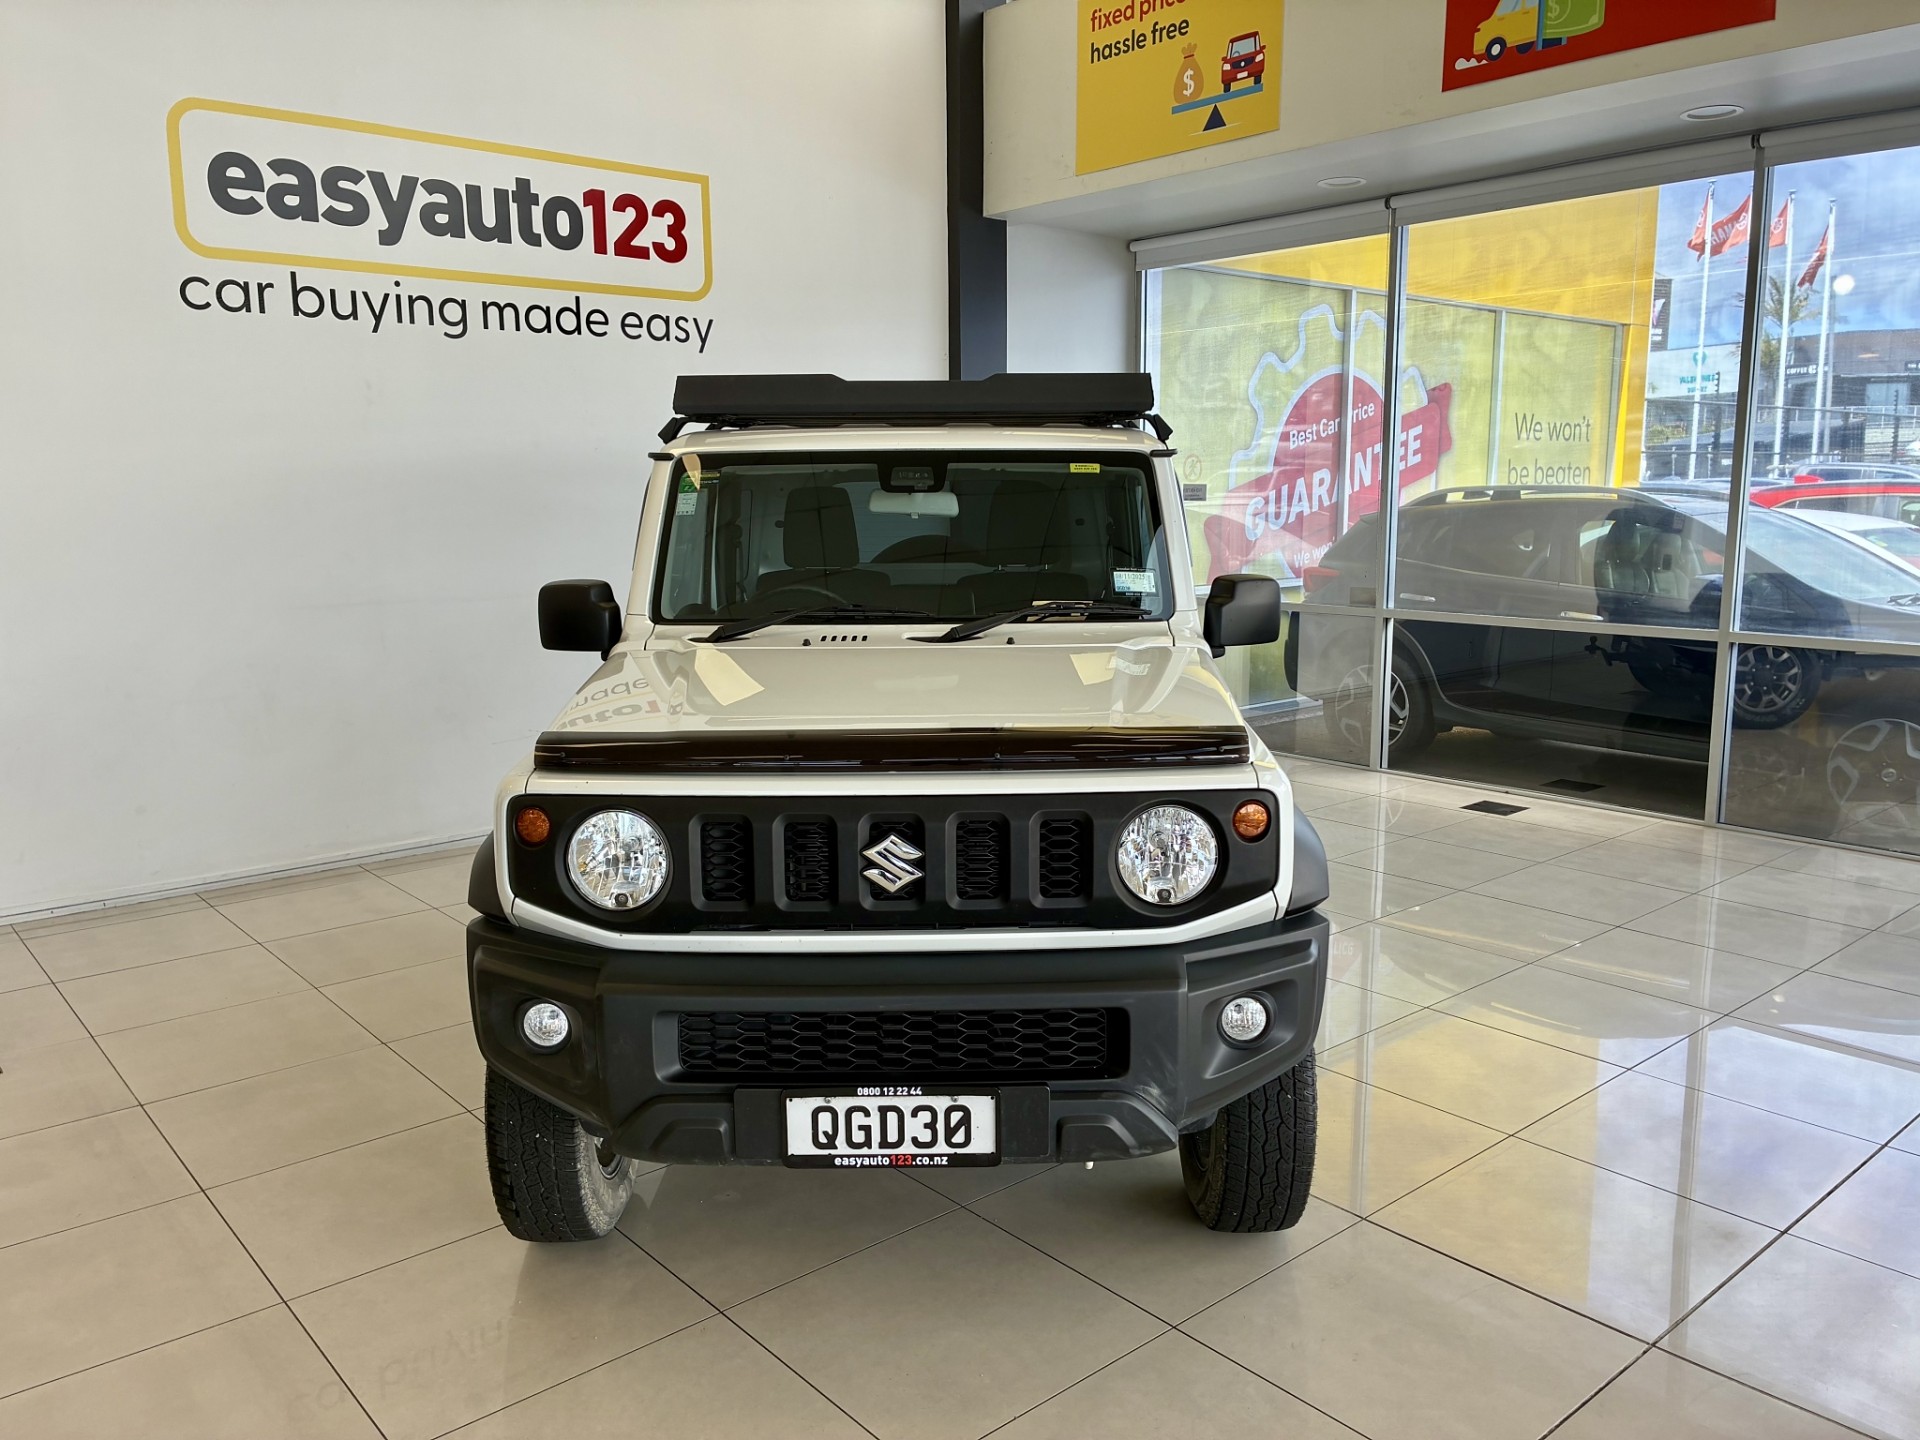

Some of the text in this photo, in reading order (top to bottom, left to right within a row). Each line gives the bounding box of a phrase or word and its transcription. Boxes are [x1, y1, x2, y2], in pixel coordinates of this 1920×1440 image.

[1090, 0, 1135, 32] fixed
[1091, 19, 1189, 64] hassle free
[207, 151, 688, 263] easyauto123
[179, 271, 714, 353] car buying made easy
[1289, 402, 1375, 450] Best Car rice
[1515, 412, 1591, 442] We won't
[1245, 424, 1423, 541] GUARNEE
[1508, 458, 1591, 485] be beaten
[1293, 550, 1311, 568] We
[857, 1086, 922, 1096] 0800 12 22 44
[811, 1104, 972, 1150] QGD30
[834, 1154, 948, 1168] easyauto123.co.nz
